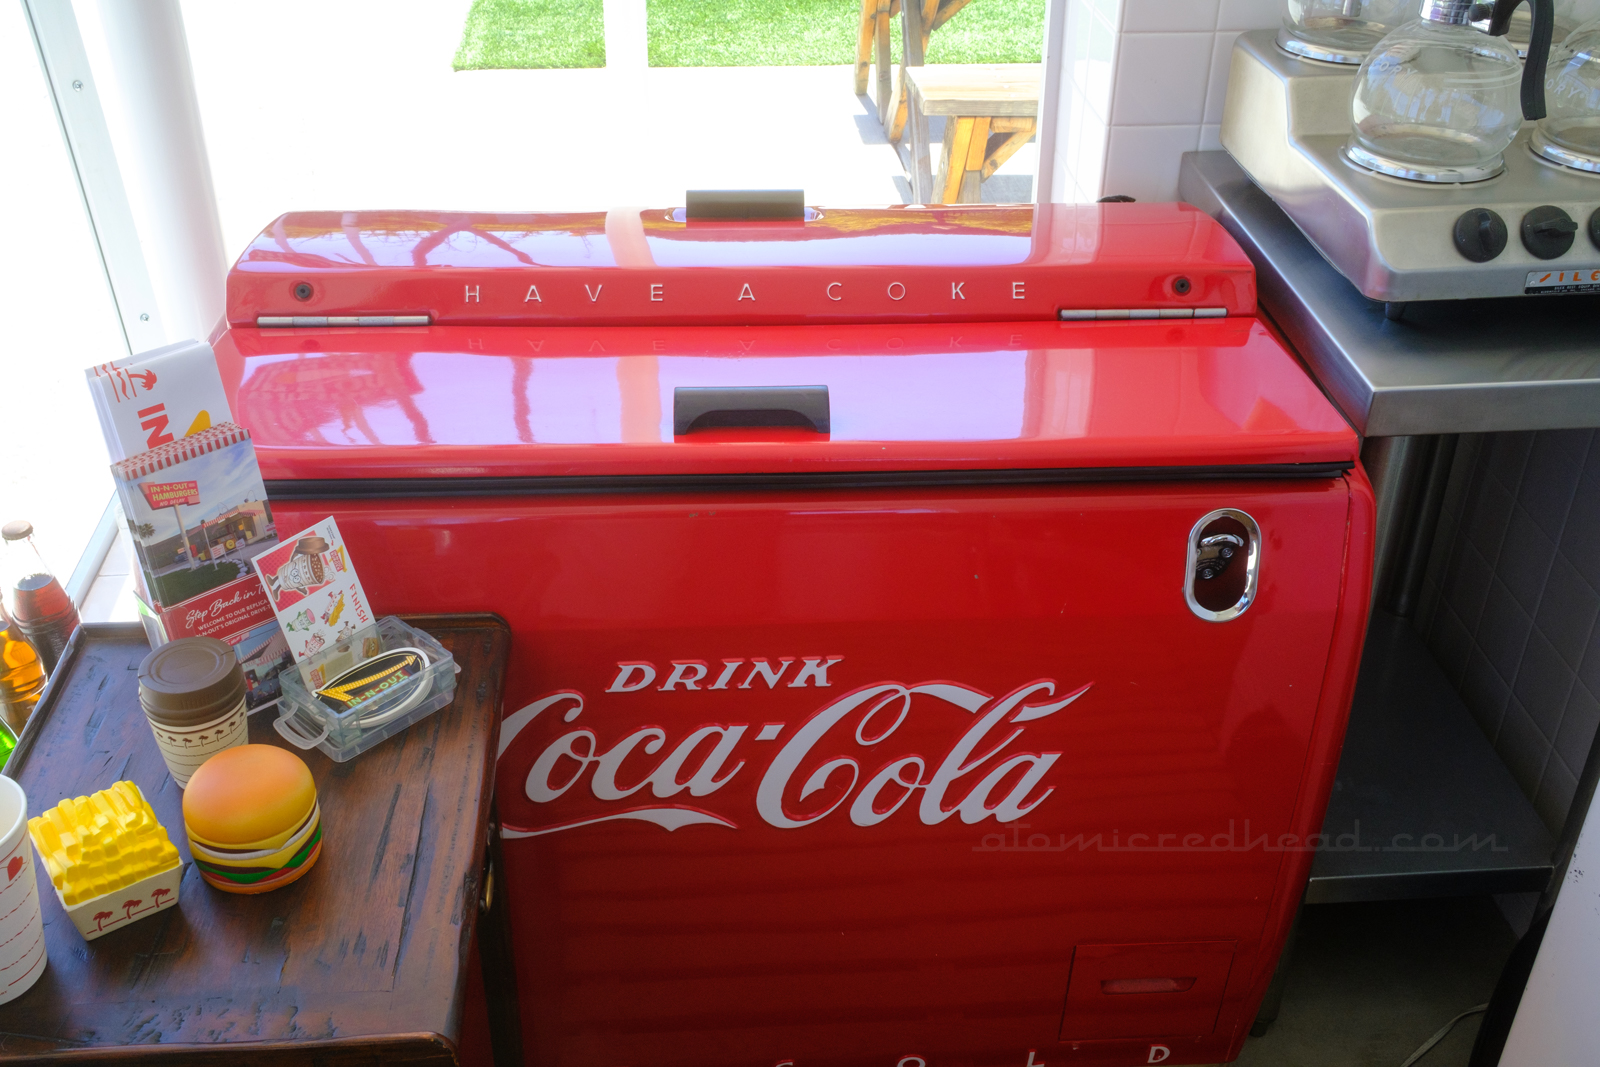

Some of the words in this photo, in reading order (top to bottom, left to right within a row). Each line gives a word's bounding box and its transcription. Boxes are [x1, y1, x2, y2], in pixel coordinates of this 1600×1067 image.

[1371, 57, 1418, 80] CORY
[464, 283, 664, 303] HAVE
[738, 283, 756, 301] A
[826, 282, 1026, 301] COKE
[150, 483, 188, 493] IN-N-OUT
[152, 488, 198, 502] HAMBURGERS
[185, 609, 208, 629] Step
[209, 591, 242, 617] Back
[243, 590, 257, 600] in
[198, 616, 225, 631] WELCOME
[233, 607, 246, 616] OUR
[246, 599, 268, 611] REPLICA
[349, 583, 369, 624] FINISH
[195, 623, 225, 637] N-N-OUT'S
[224, 613, 250, 627] ORIGINAL
[605, 655, 845, 693] DRINK
[346, 670, 402, 707] IN-N-OUT
[499, 678, 1094, 838] Coca-Cola
[775, 1045, 1171, 1067] OLD
